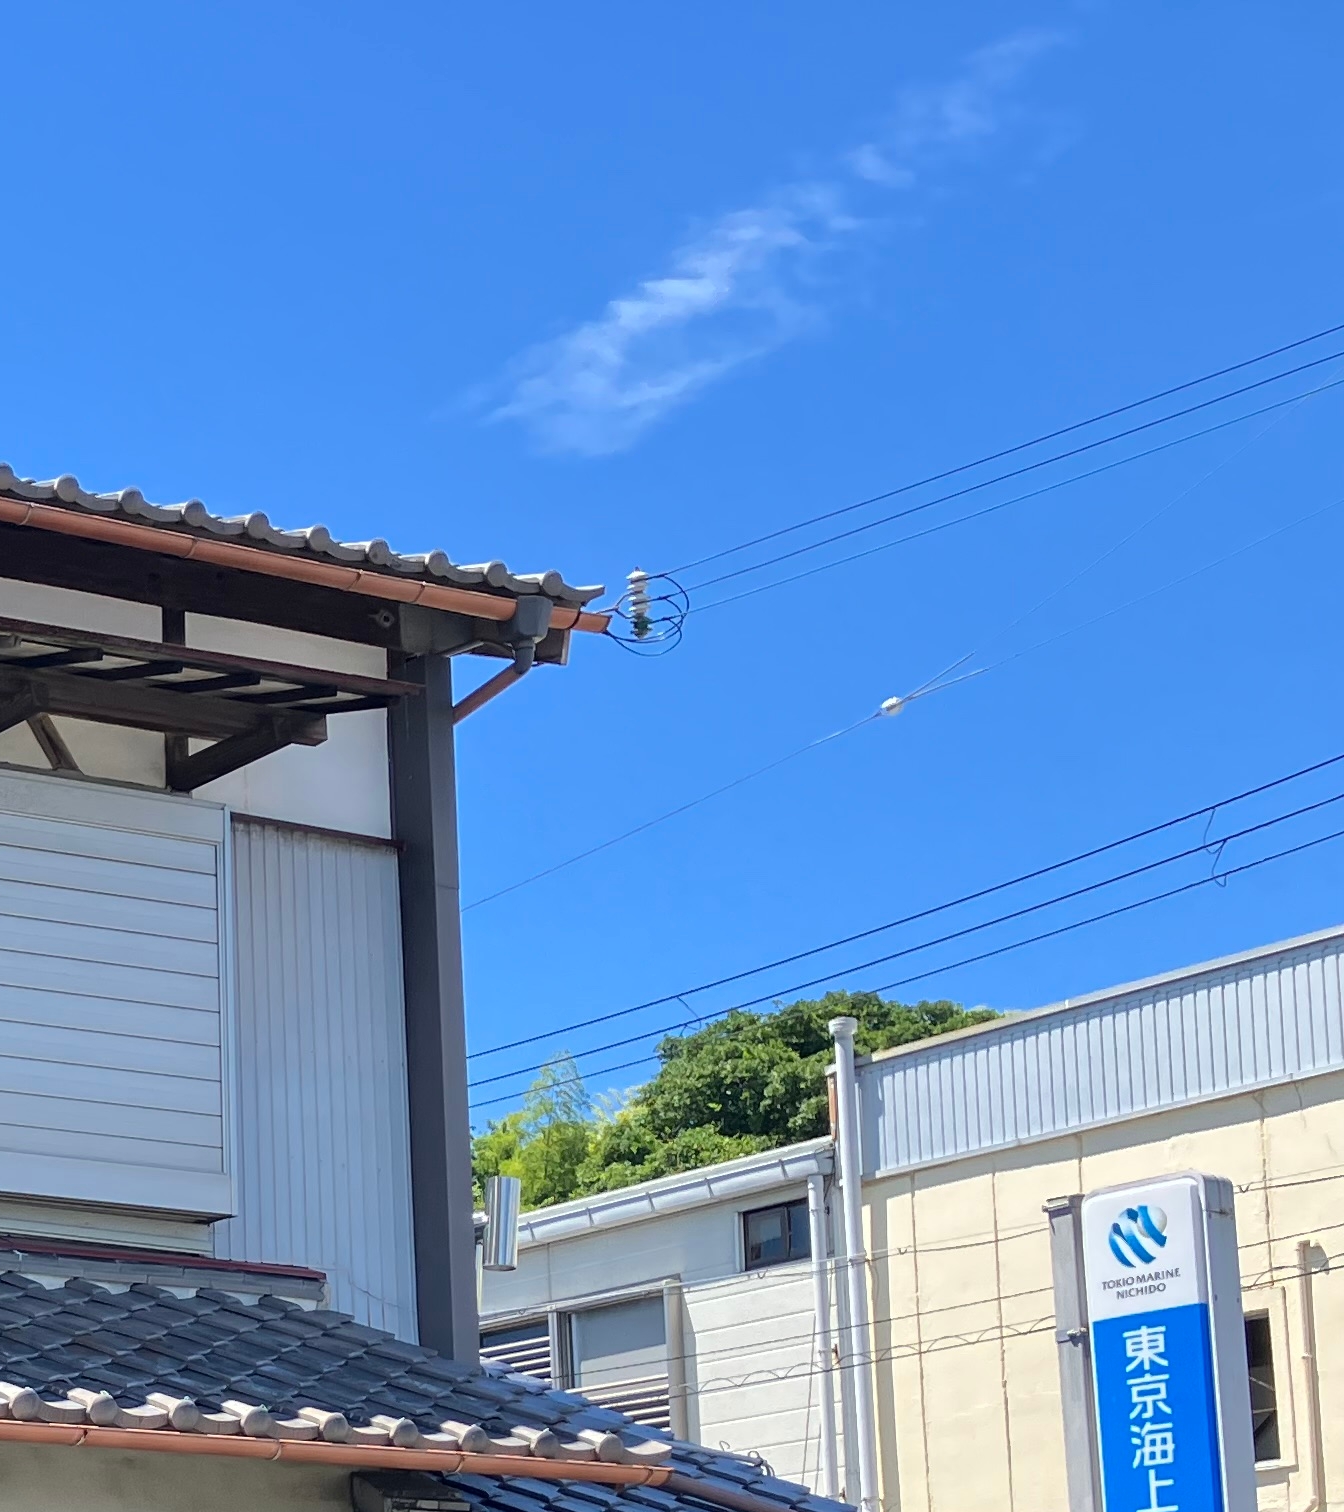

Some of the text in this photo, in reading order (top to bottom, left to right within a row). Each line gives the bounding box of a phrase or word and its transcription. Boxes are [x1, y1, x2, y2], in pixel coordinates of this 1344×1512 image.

[1101, 1267, 1181, 1291] TOKIO MARINE
[1116, 1282, 1166, 1300] NICHIDO
